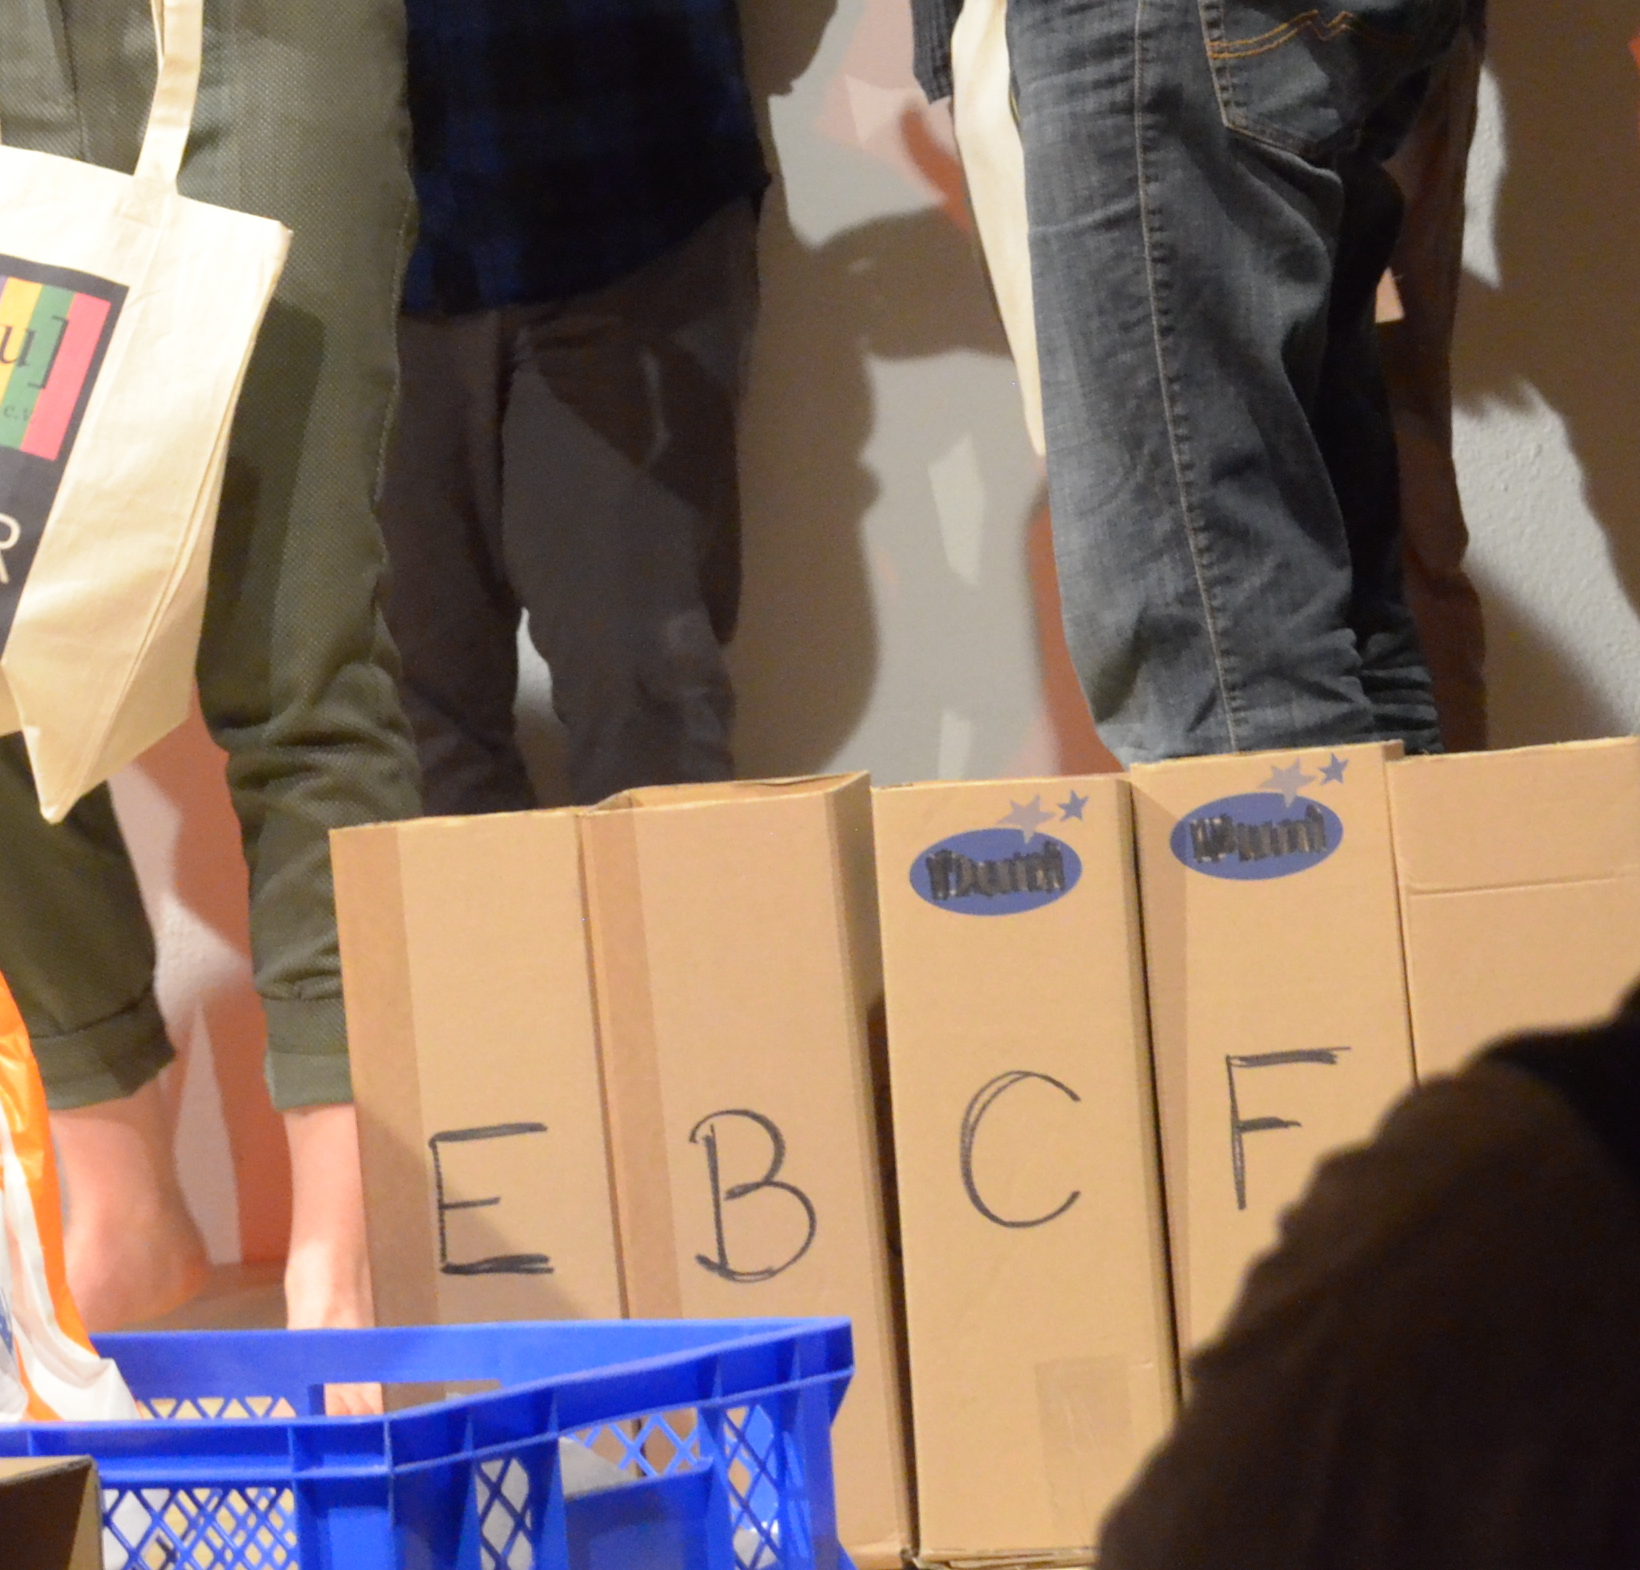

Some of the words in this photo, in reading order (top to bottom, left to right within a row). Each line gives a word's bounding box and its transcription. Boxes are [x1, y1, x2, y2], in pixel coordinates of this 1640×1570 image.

[429, 1122, 555, 1275] E
[688, 1108, 817, 1283] B
[958, 1070, 1082, 1229] C
[1224, 1046, 1351, 1212] F
